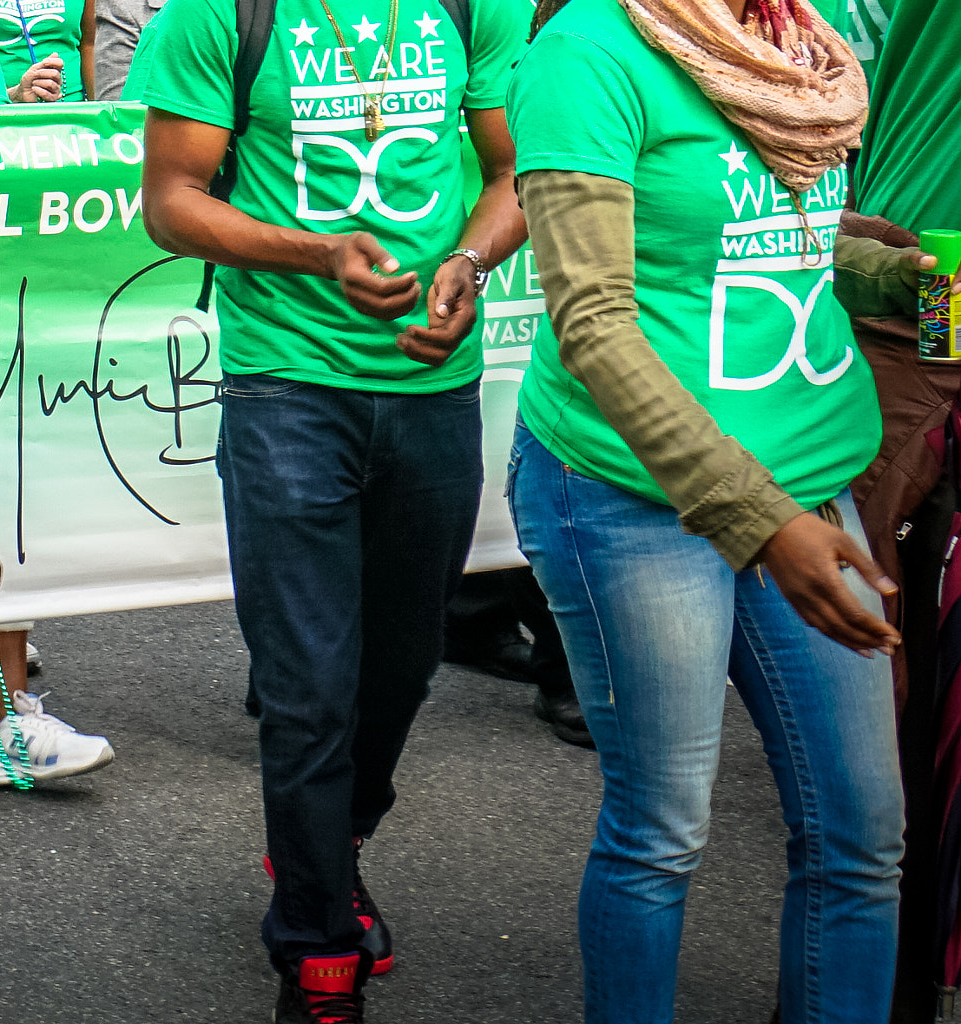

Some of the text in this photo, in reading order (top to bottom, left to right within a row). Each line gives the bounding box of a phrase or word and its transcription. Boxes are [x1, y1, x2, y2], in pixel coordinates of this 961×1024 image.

[289, 40, 446, 84] WE ARE
[292, 127, 440, 222] DC
[721, 172, 791, 220] WE
[721, 226, 839, 258] WASHINGT
[709, 269, 854, 391] DC
